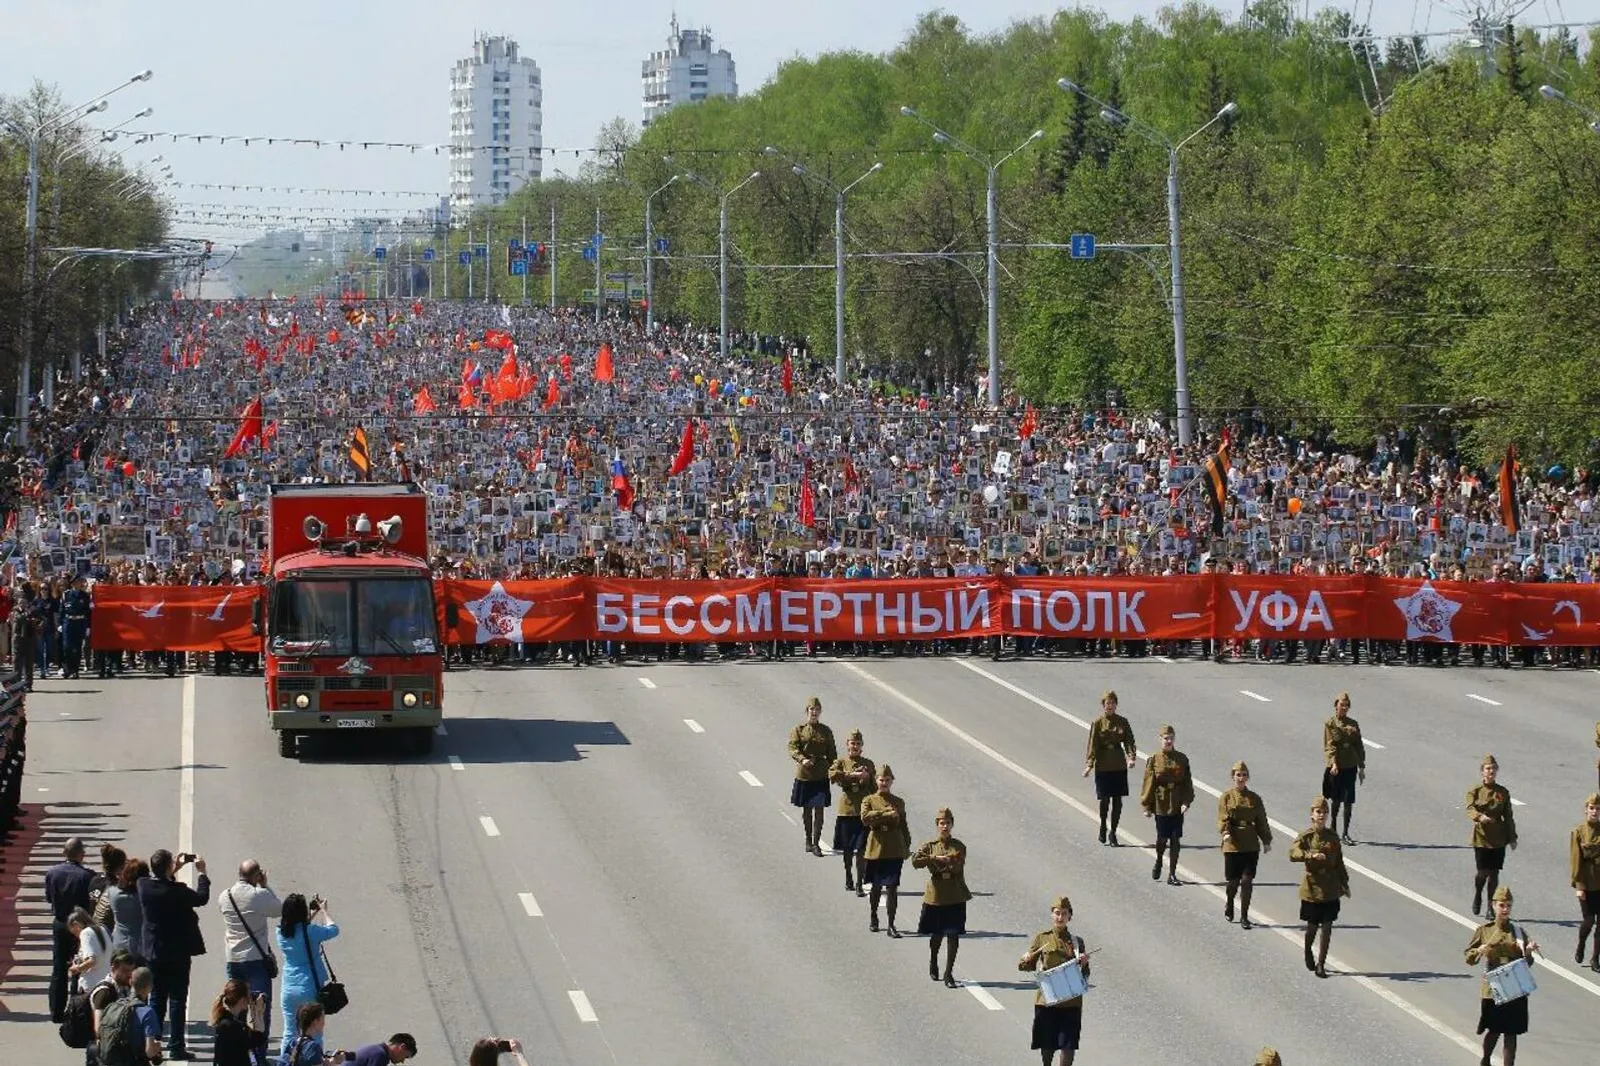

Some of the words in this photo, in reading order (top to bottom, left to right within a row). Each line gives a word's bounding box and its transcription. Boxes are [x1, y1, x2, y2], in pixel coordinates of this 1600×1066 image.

[595, 582, 991, 634] БЕССМЕРТНЫЙ
[1011, 589, 1146, 633] ПОЛК
[1229, 589, 1334, 632] УФА
